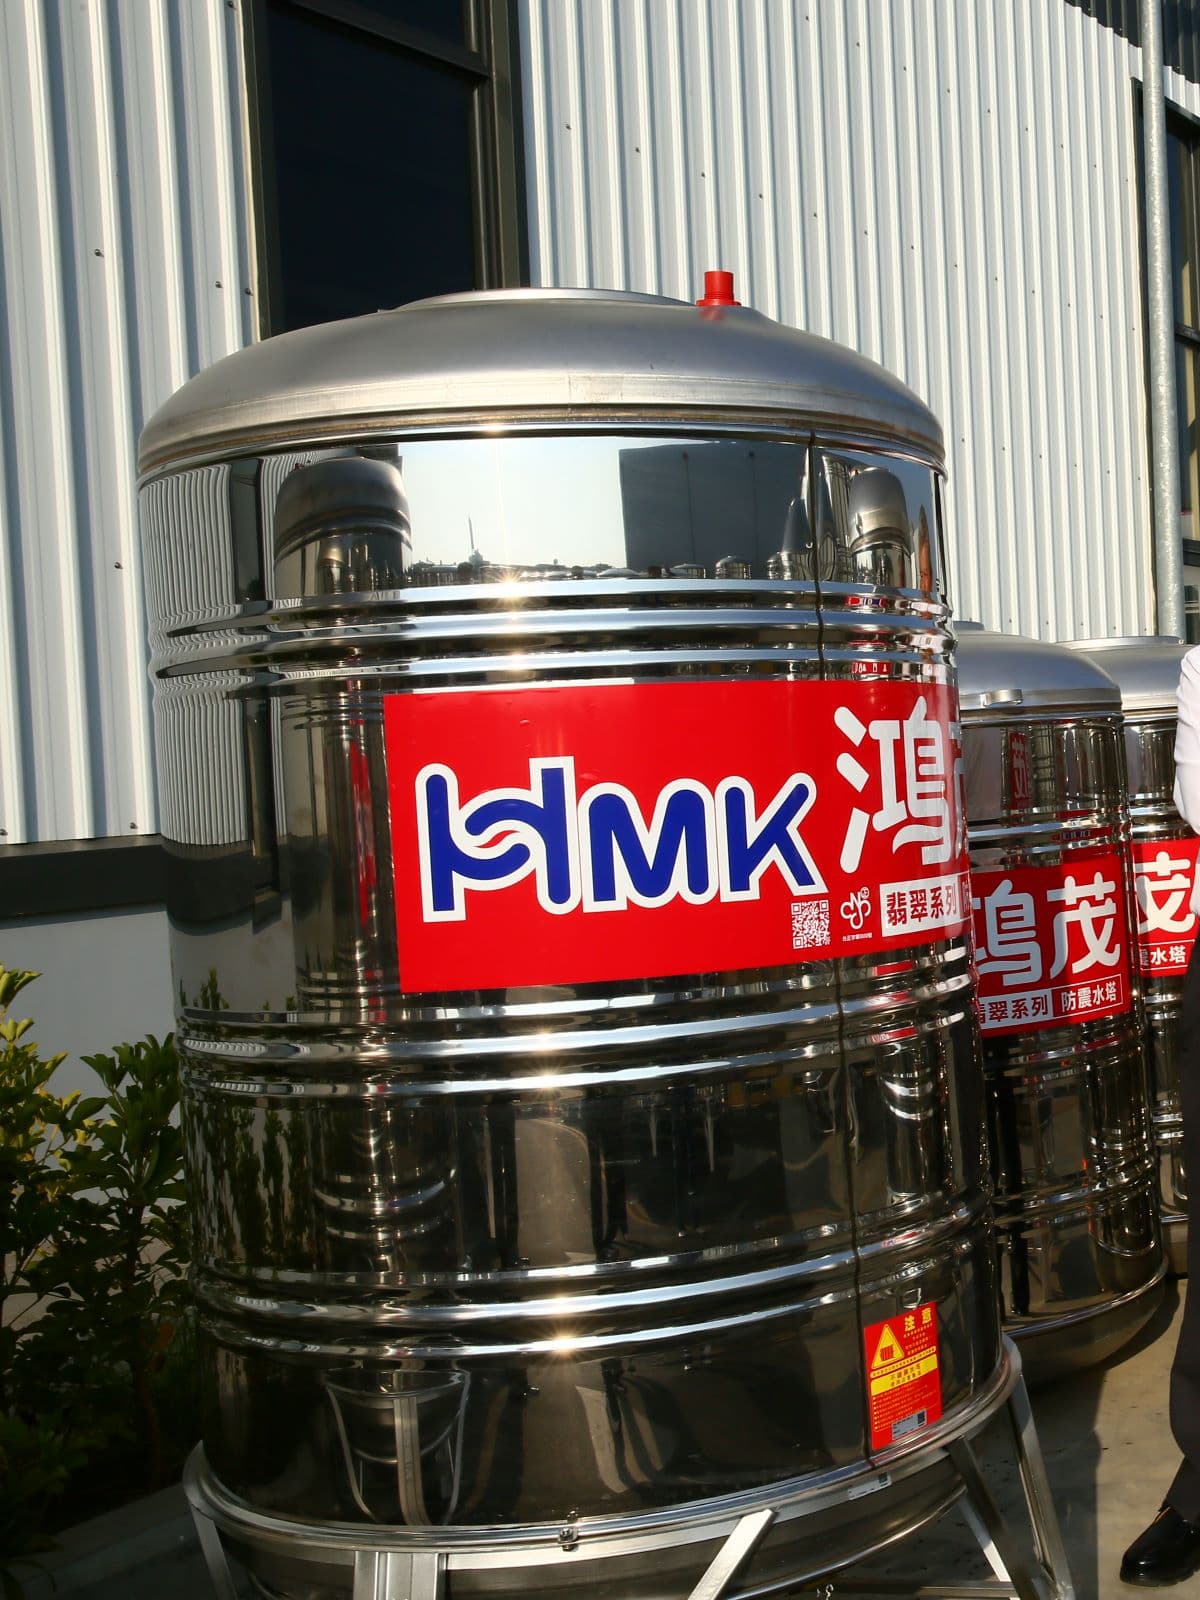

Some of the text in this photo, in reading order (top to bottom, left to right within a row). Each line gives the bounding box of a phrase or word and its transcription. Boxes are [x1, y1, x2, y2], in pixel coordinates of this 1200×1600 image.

[833, 696, 964, 874] 鴻
[415, 755, 829, 923] HMK
[886, 886, 957, 926] 翡翠系列
[1061, 980, 1117, 1012] 防震水塔
